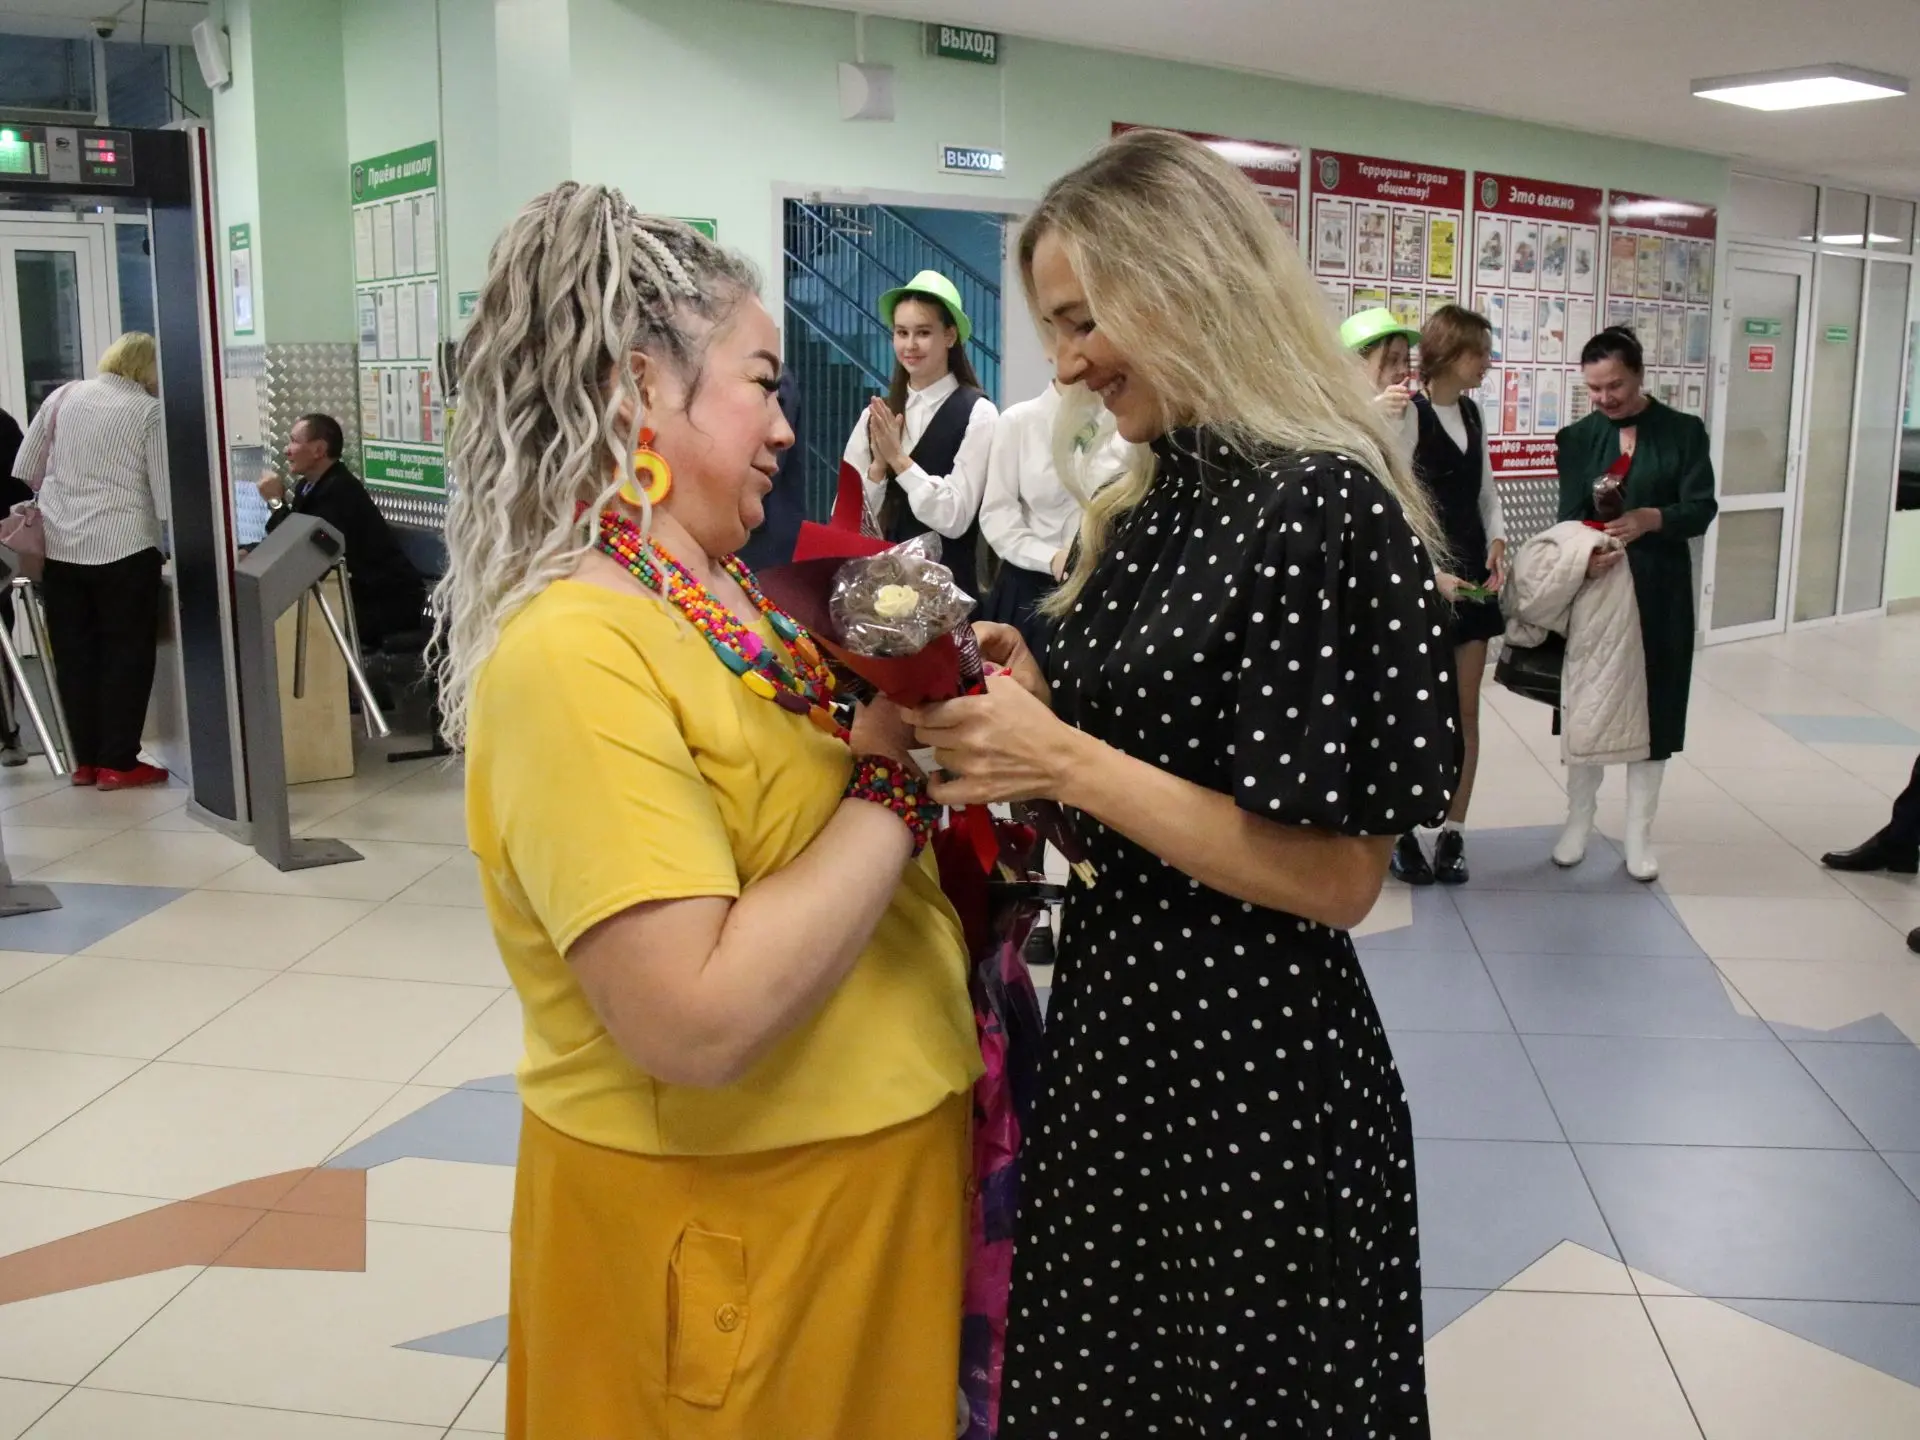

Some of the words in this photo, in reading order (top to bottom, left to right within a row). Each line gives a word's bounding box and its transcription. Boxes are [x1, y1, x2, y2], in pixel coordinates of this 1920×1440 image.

[941, 27, 995, 58] ВЫХОД
[368, 163, 396, 190] Приём
[403, 156, 432, 177] школу
[1358, 162, 1411, 180] Терроризм
[1416, 172, 1448, 185] угроза
[1377, 181, 1430, 201] обществу!
[1508, 185, 1536, 205] Это
[1537, 193, 1575, 210] важно
[1525, 443, 1559, 455] простр
